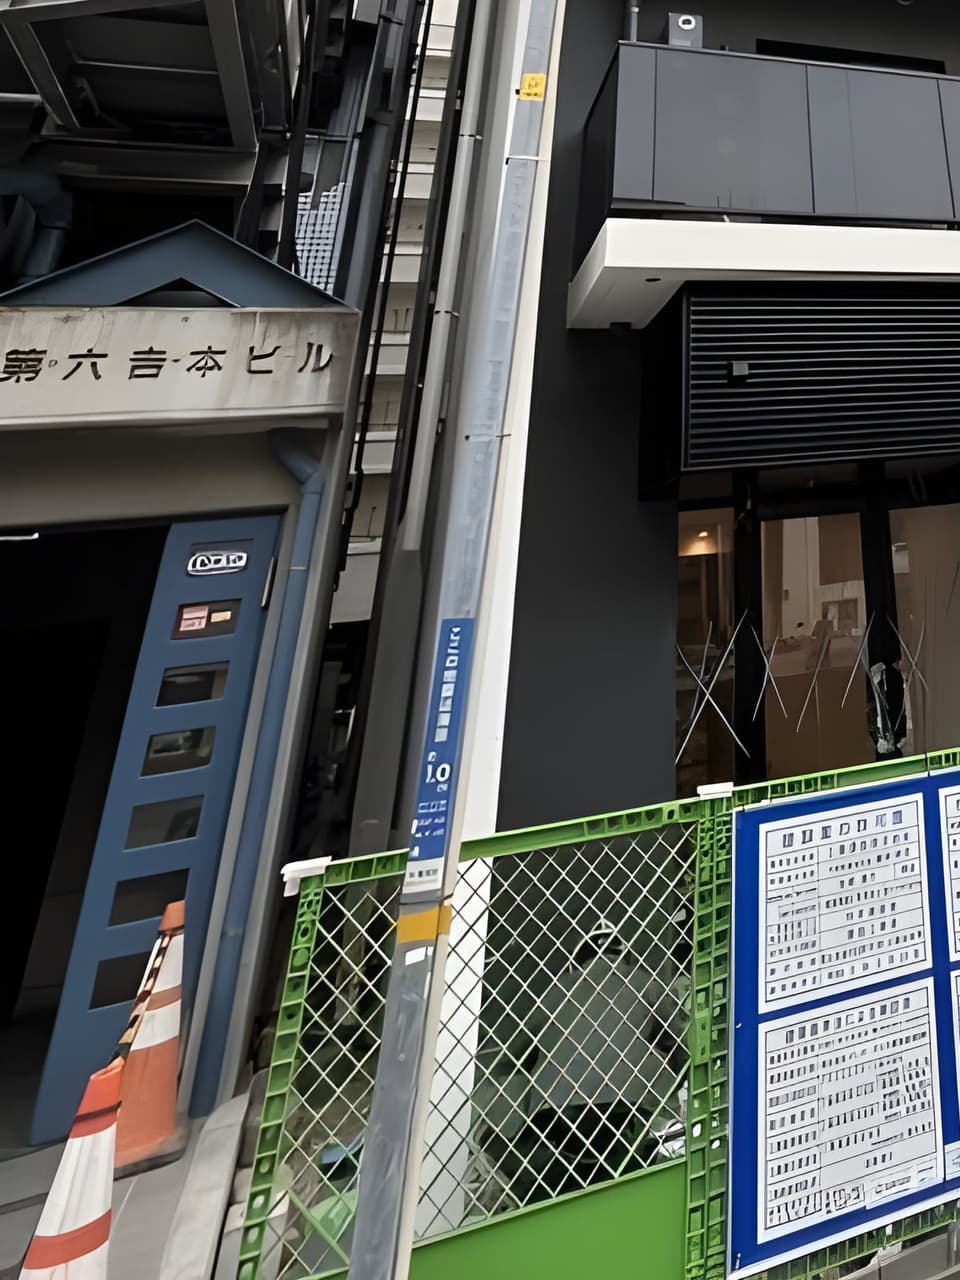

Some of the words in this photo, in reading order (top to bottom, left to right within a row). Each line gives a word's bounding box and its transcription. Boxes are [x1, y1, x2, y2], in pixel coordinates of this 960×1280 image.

[0, 342, 333, 383] 第六吉本ビル
